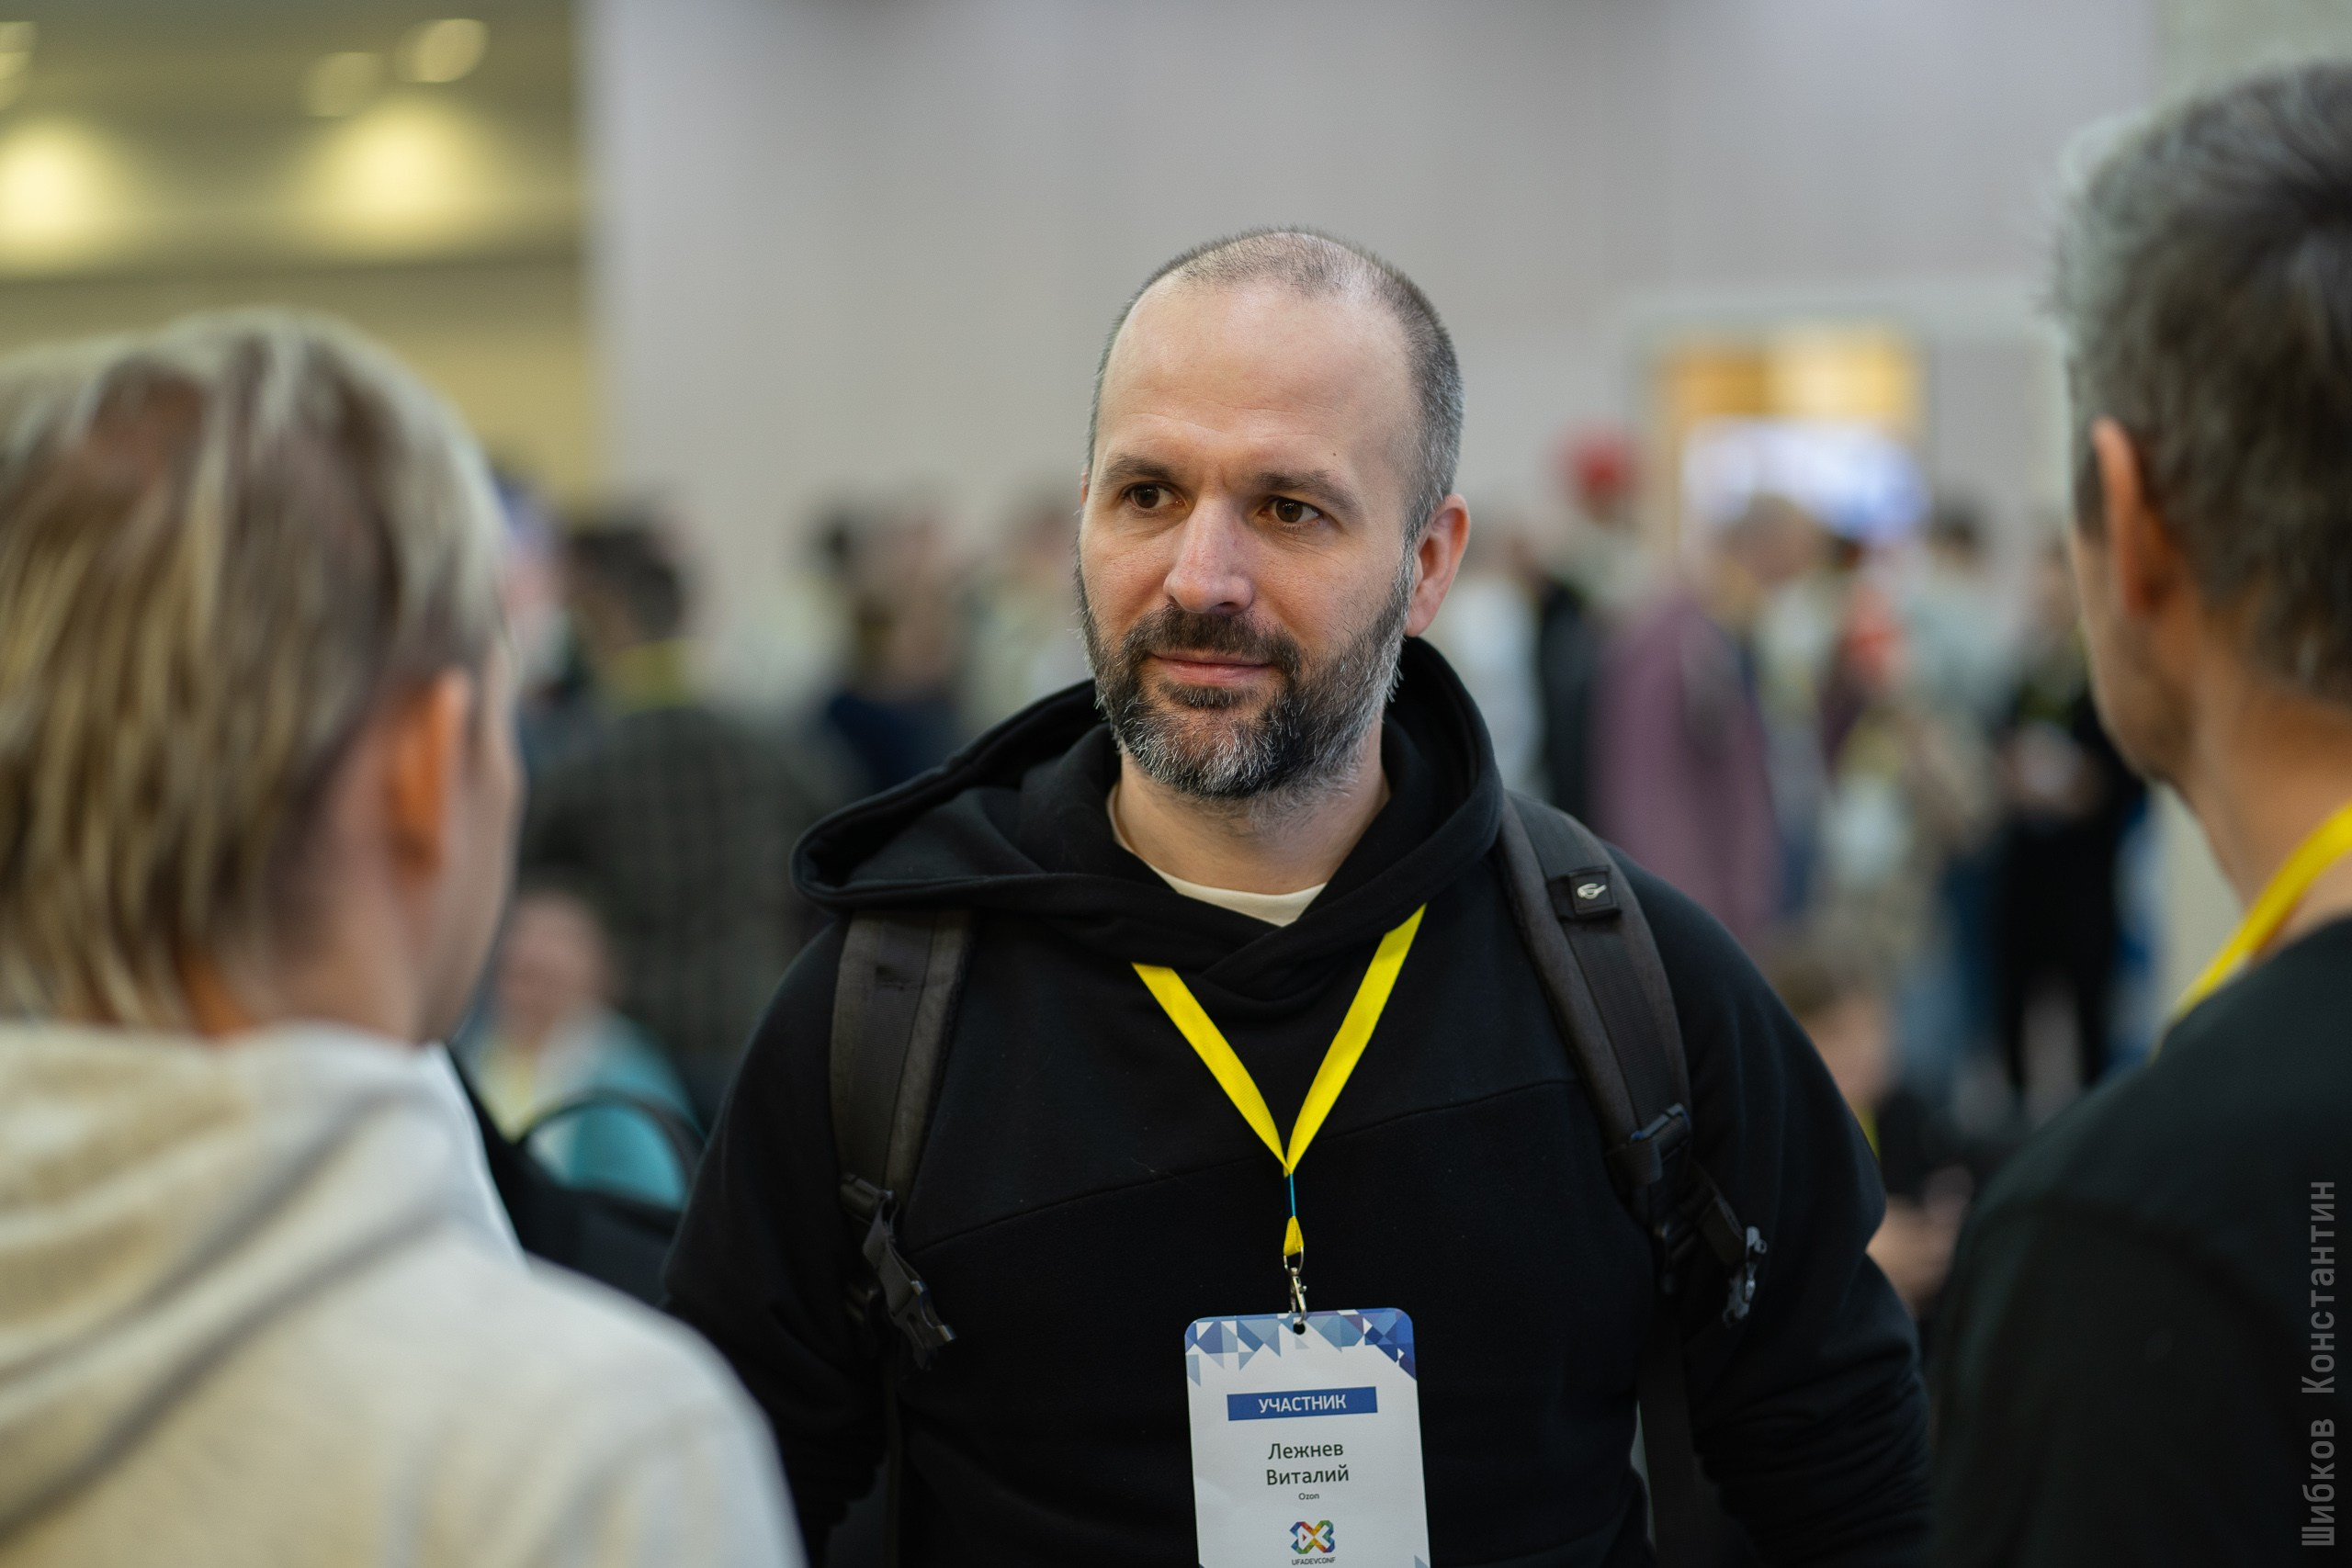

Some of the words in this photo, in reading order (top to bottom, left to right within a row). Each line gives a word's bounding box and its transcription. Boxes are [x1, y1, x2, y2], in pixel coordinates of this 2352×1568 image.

[1258, 1393, 1347, 1414] УЧАСТНИК
[1268, 1442, 1344, 1460] Лежнев
[1266, 1464, 1350, 1485] Виталий
[1298, 1492, 1320, 1500] Ozon
[1291, 1556, 1336, 1565] UFADEVCONF
